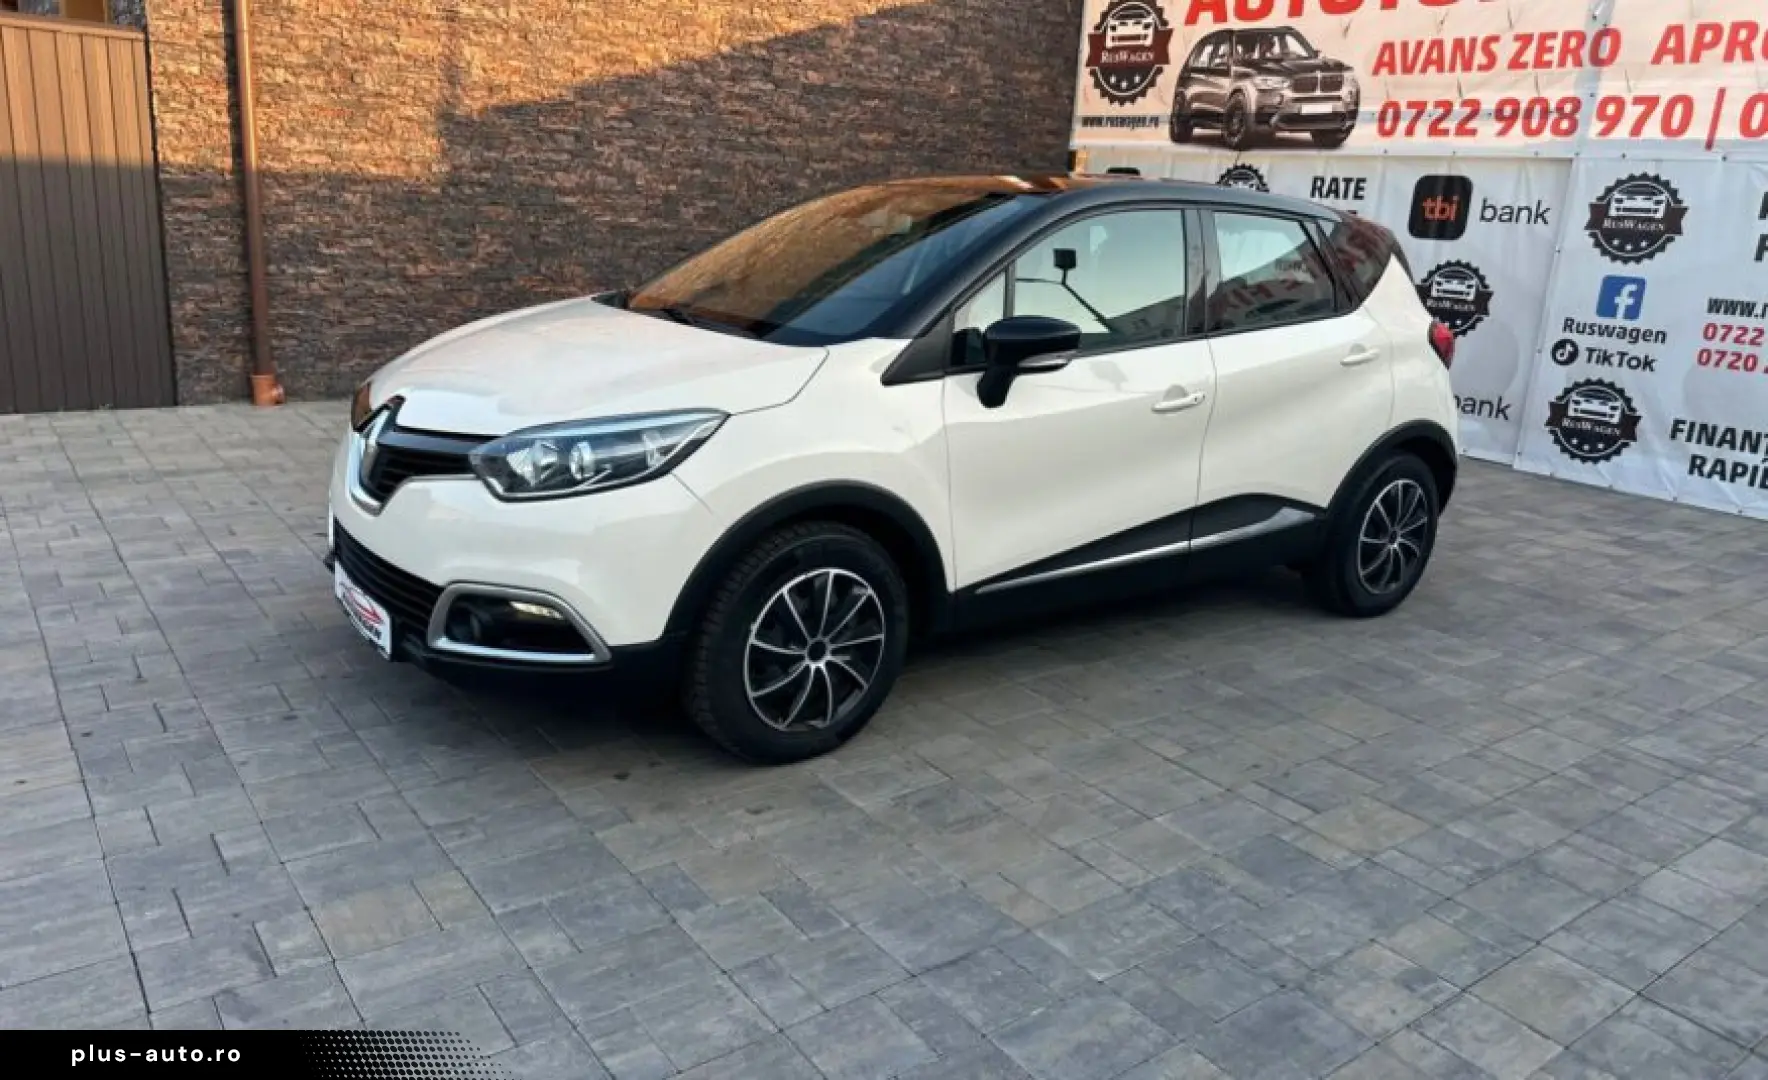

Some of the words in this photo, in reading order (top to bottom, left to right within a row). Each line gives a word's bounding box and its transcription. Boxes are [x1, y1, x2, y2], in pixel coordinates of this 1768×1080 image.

[1372, 35, 1500, 76] AVANS
[1508, 28, 1621, 69] ZERO
[1651, 21, 1768, 65] APR
[1377, 98, 1481, 138] 0722
[1494, 96, 1582, 137] 908
[1596, 94, 1695, 138] 970
[1311, 176, 1367, 200] RATE
[1422, 195, 1459, 221] tbi
[1479, 196, 1550, 225] bank
[1562, 316, 1667, 344] Ruswagen
[1702, 322, 1765, 347] 0722
[1584, 346, 1657, 372] TikTok
[1697, 348, 1758, 372] 0720
